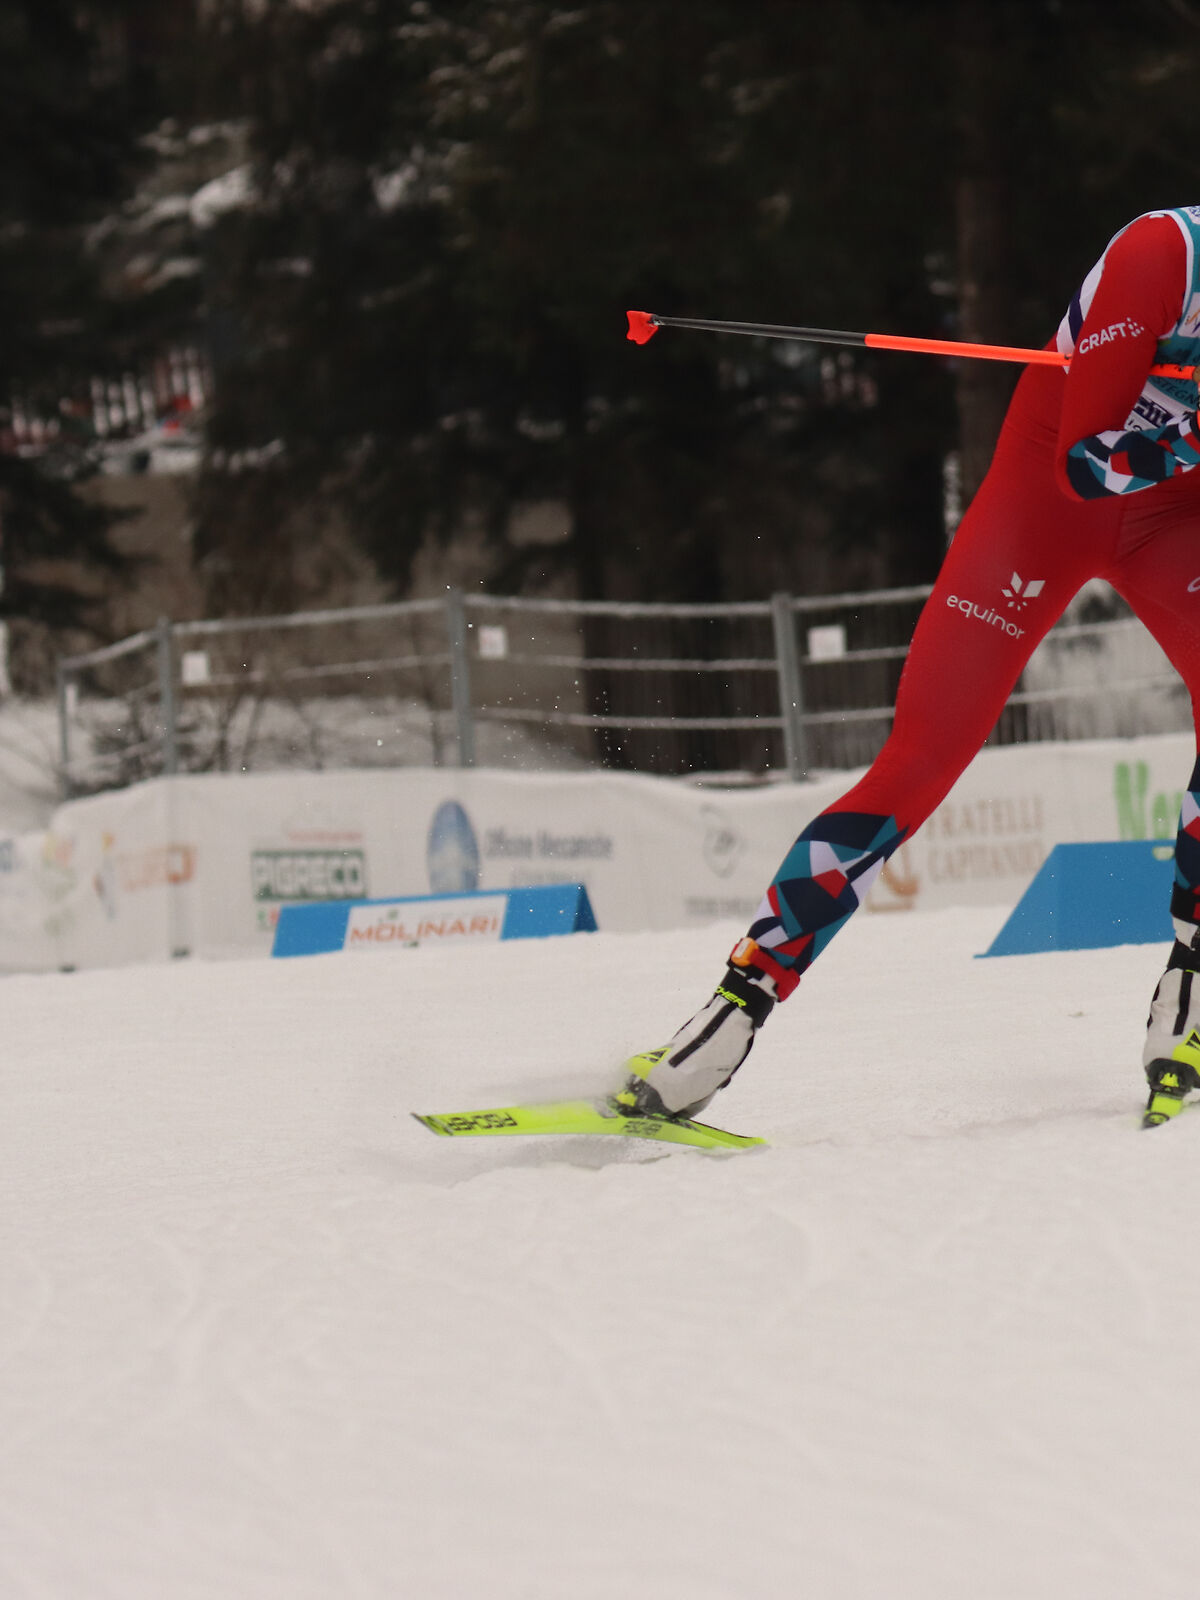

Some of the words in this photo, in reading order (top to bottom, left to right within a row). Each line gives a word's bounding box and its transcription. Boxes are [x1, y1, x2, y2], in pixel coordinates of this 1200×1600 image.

[1079, 322, 1126, 354] CRAFT
[946, 594, 1026, 640] equinor
[350, 916, 498, 943] MOLINARI
